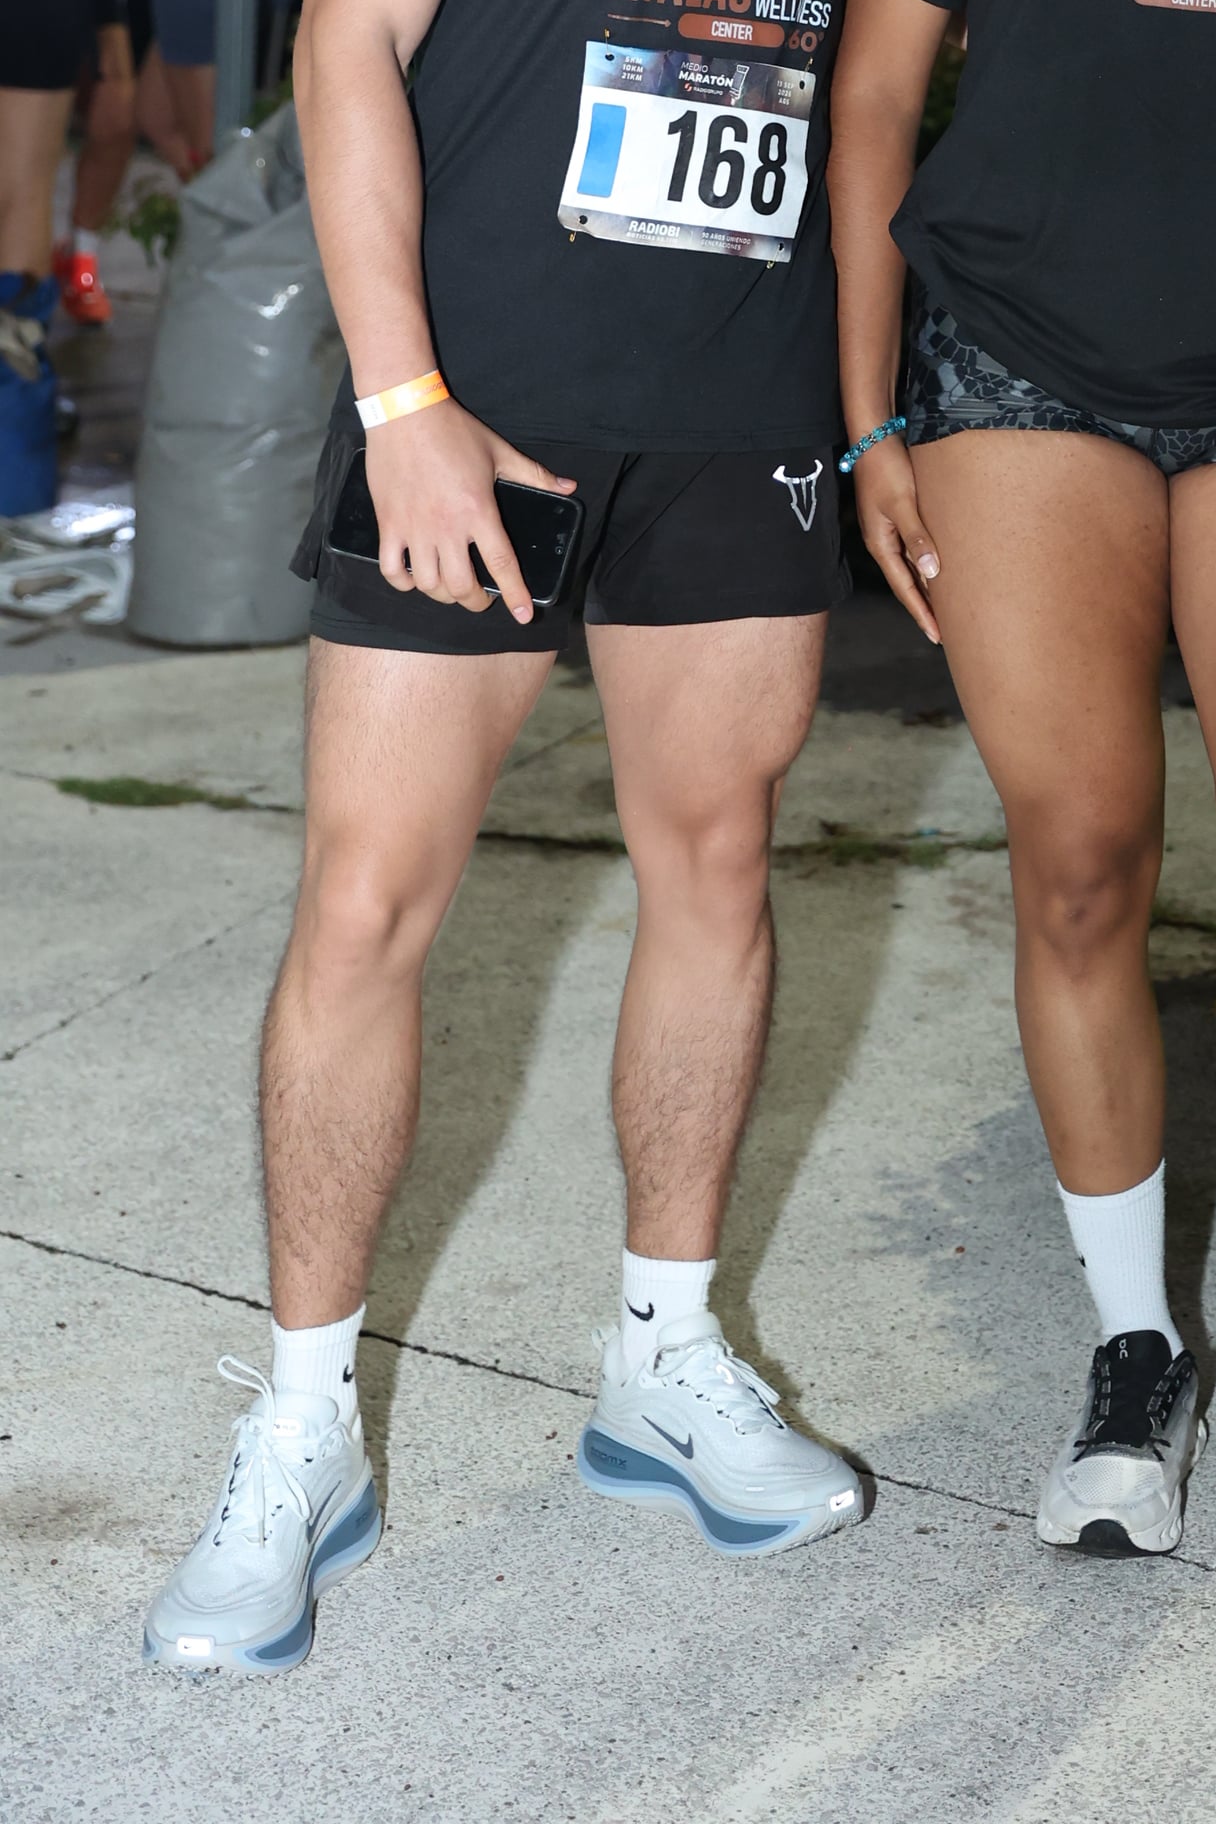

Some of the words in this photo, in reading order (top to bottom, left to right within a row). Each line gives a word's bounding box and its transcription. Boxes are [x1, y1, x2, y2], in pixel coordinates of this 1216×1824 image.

[711, 20, 754, 41] CENTER
[786, 28, 825, 53] 60°
[622, 63, 644, 73] 10KM
[680, 61, 709, 73] MEDIO
[621, 72, 643, 81] 21KM
[678, 70, 734, 87] MARATÓN
[667, 109, 789, 217] 168
[628, 220, 681, 238] RADIOBI
